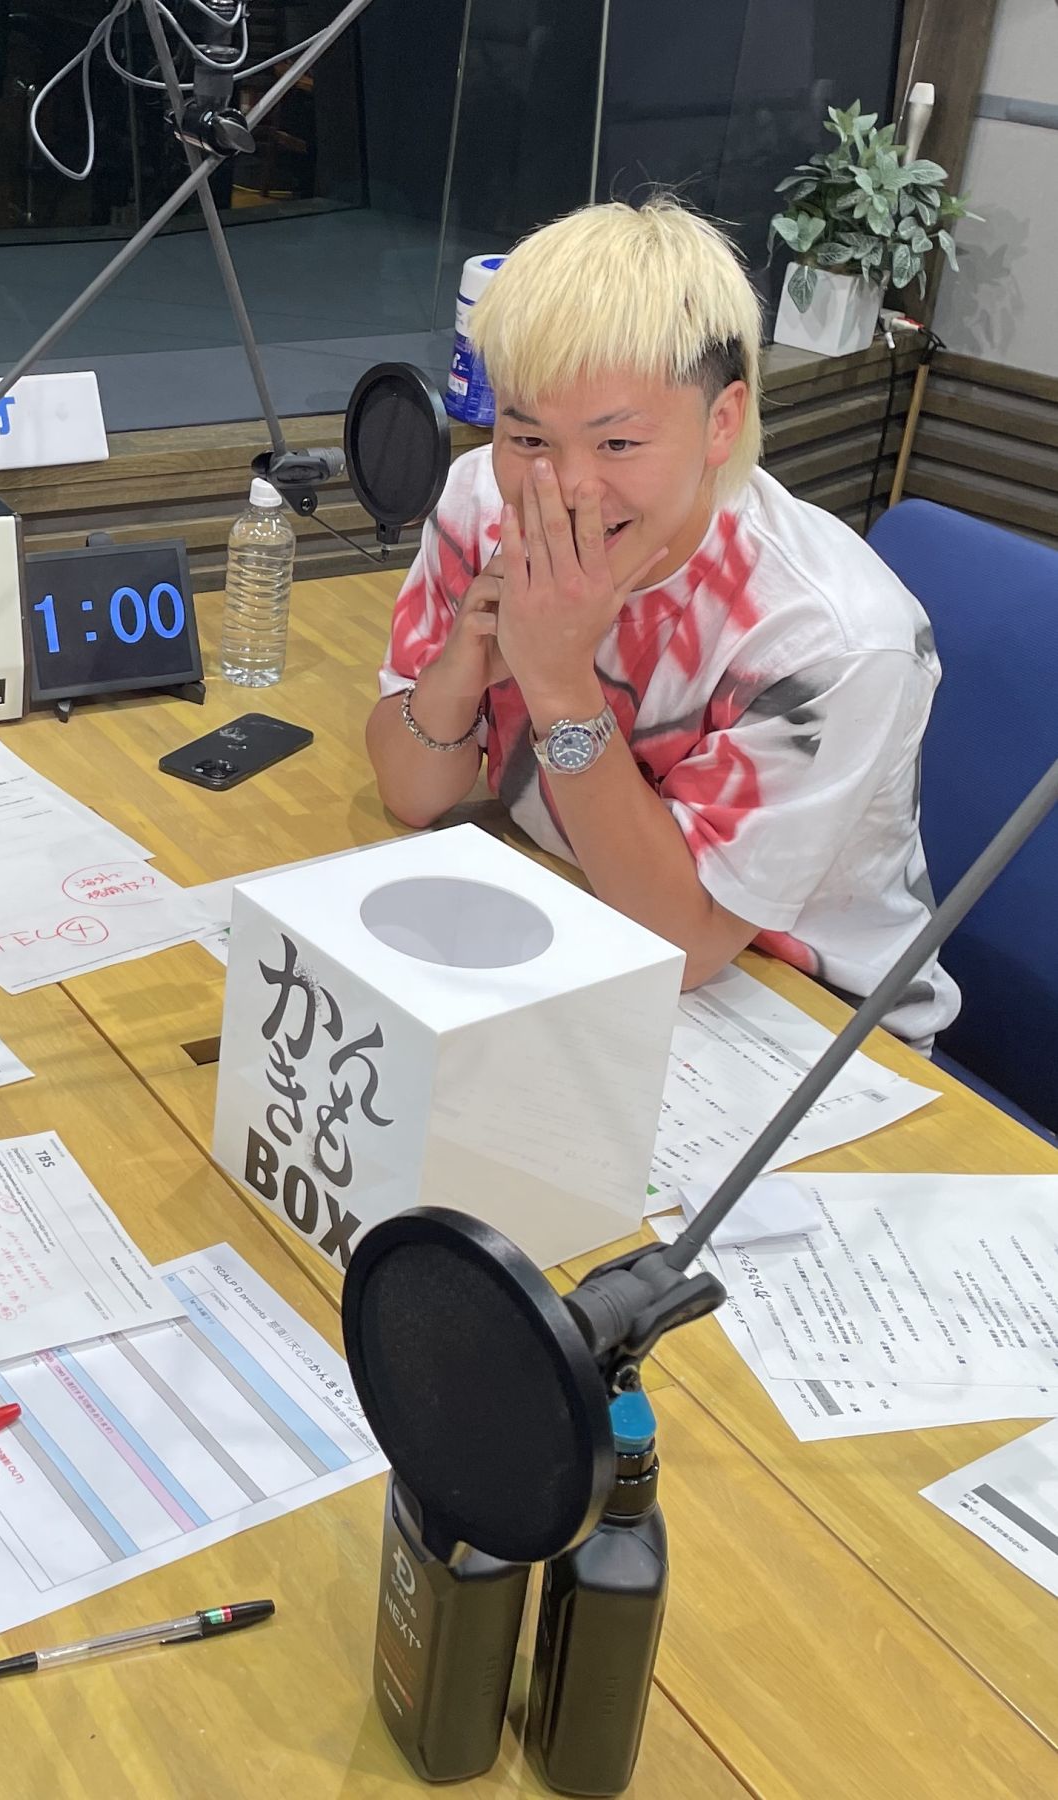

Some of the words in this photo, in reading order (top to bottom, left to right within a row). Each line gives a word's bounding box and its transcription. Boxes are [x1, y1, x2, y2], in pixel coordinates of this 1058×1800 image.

[34, 1148, 56, 1169] TBS
[245, 1126, 363, 1271] BOX
[212, 1263, 239, 1288] SCALP
[238, 1291, 268, 1320] presents
